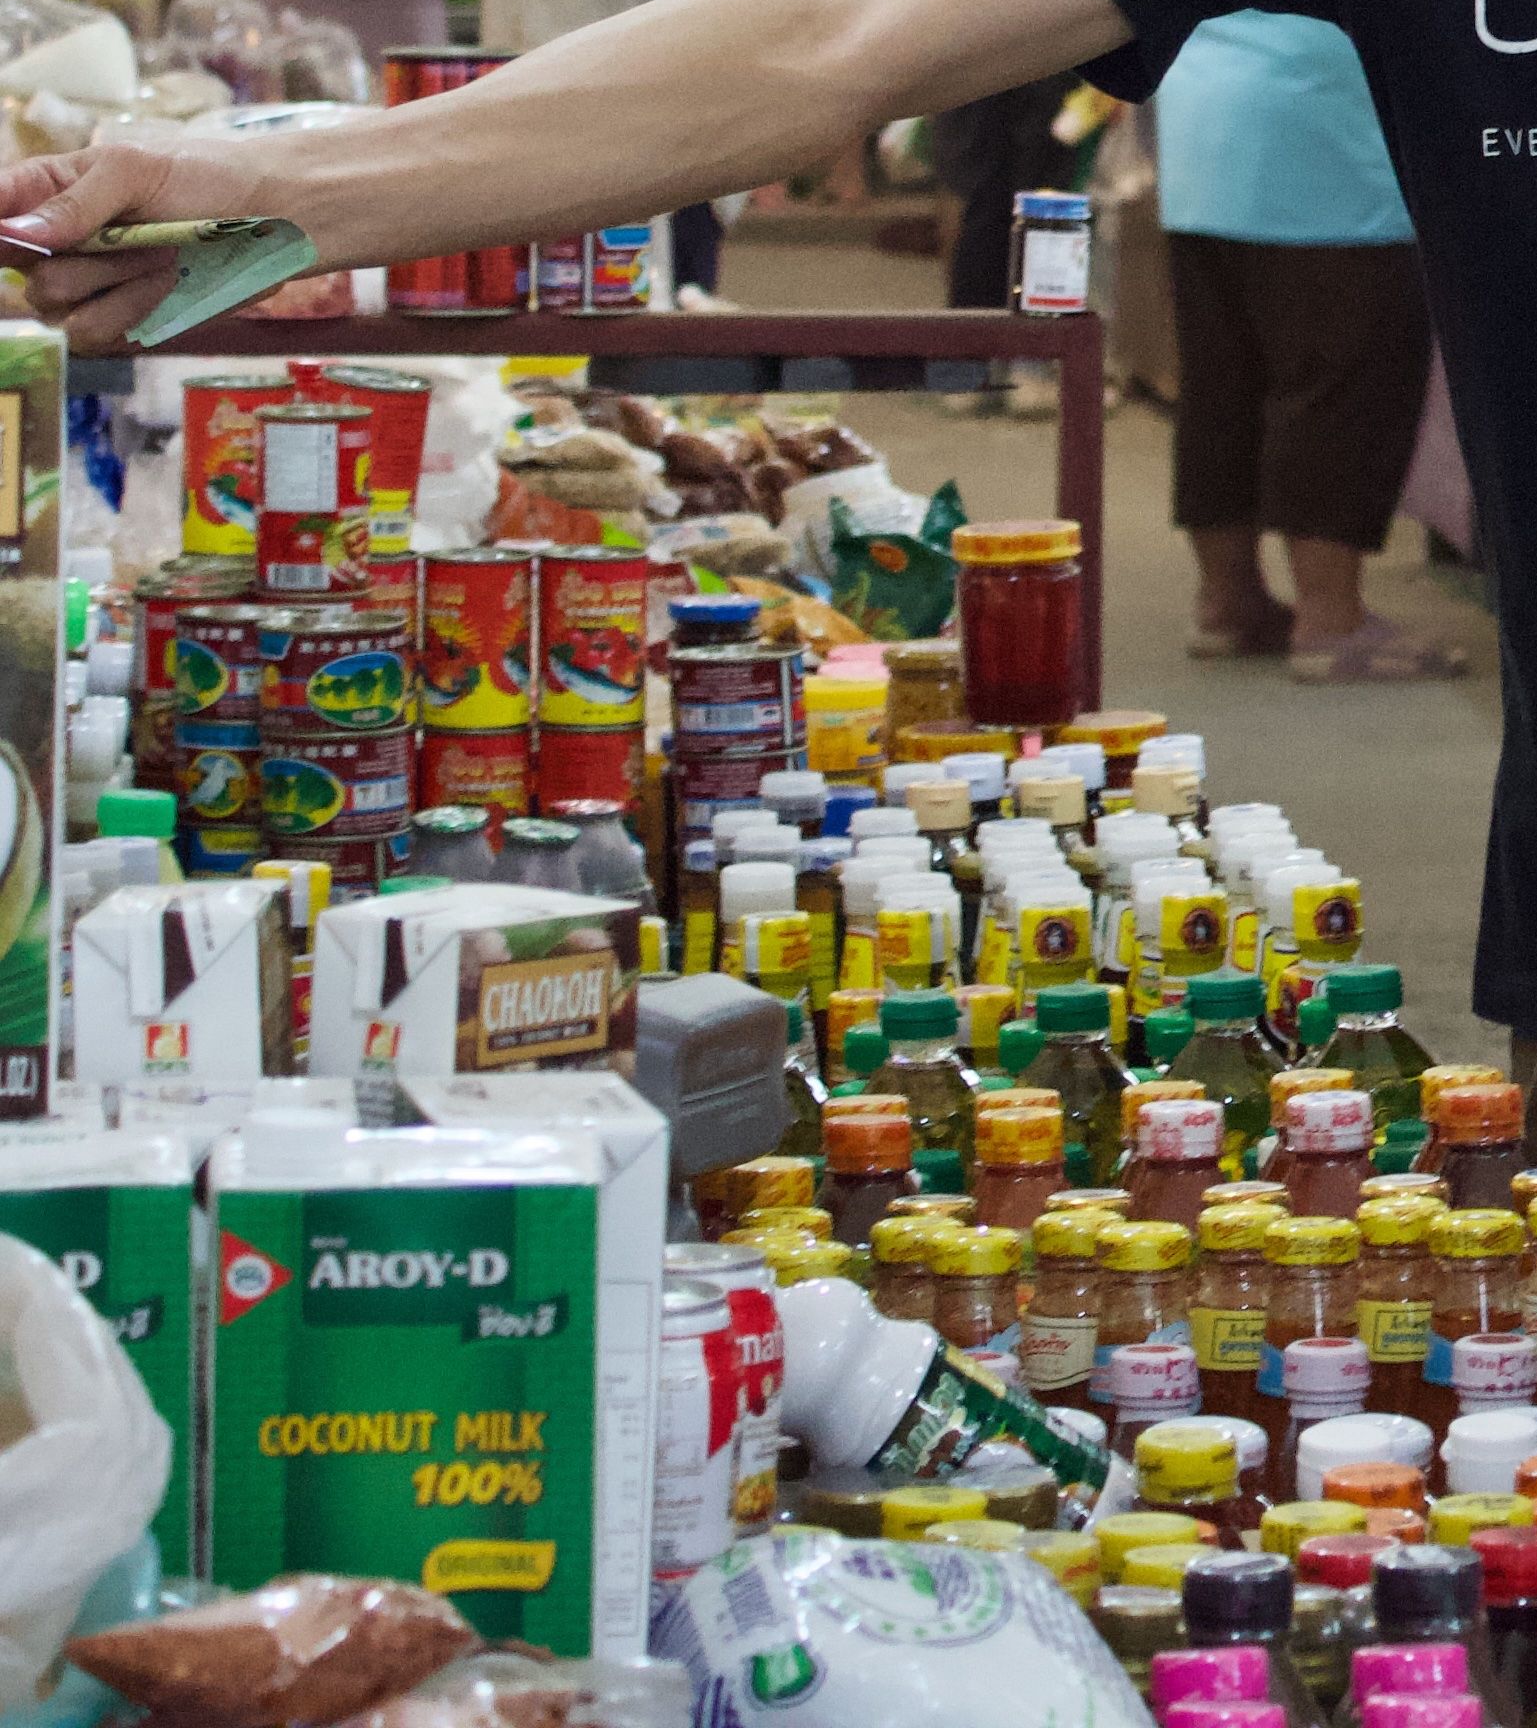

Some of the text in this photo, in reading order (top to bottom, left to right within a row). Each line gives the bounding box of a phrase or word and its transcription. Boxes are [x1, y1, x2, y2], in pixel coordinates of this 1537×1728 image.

[308, 1248, 509, 1289] AROY-D
[258, 1411, 547, 1457] COCONUT MILK
[412, 1460, 544, 1506] 100%
